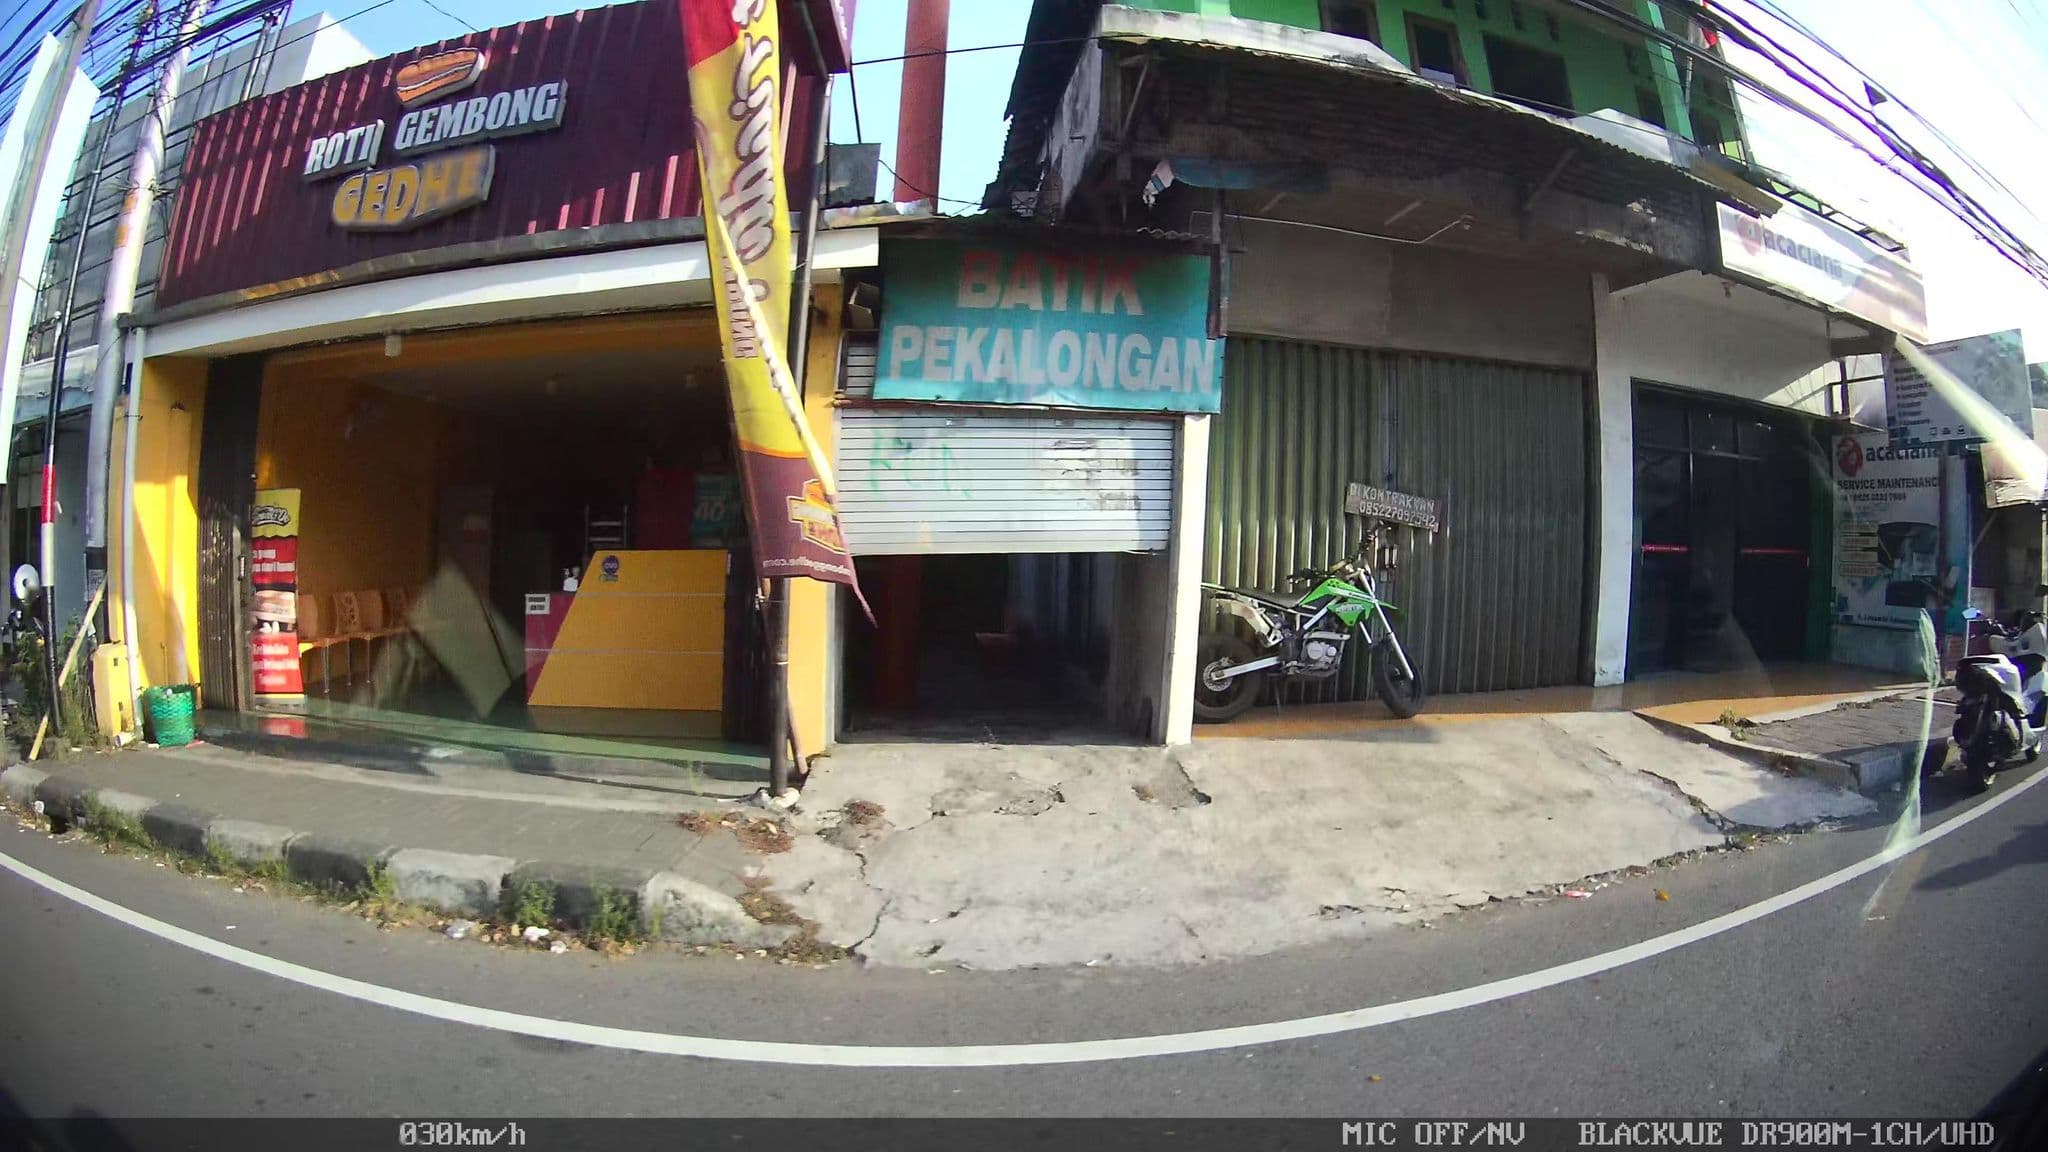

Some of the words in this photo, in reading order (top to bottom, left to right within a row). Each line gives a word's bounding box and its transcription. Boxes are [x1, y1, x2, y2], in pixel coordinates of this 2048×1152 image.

[304, 124, 377, 175] ROTI
[394, 83, 561, 150] GEMBONG
[333, 150, 488, 225] GEDHE
[958, 251, 1144, 316] BATIK
[889, 325, 1216, 394] PEKALONGAN
[1837, 479, 1876, 490] SERVICE
[1877, 477, 1942, 489] MAINTENANC
